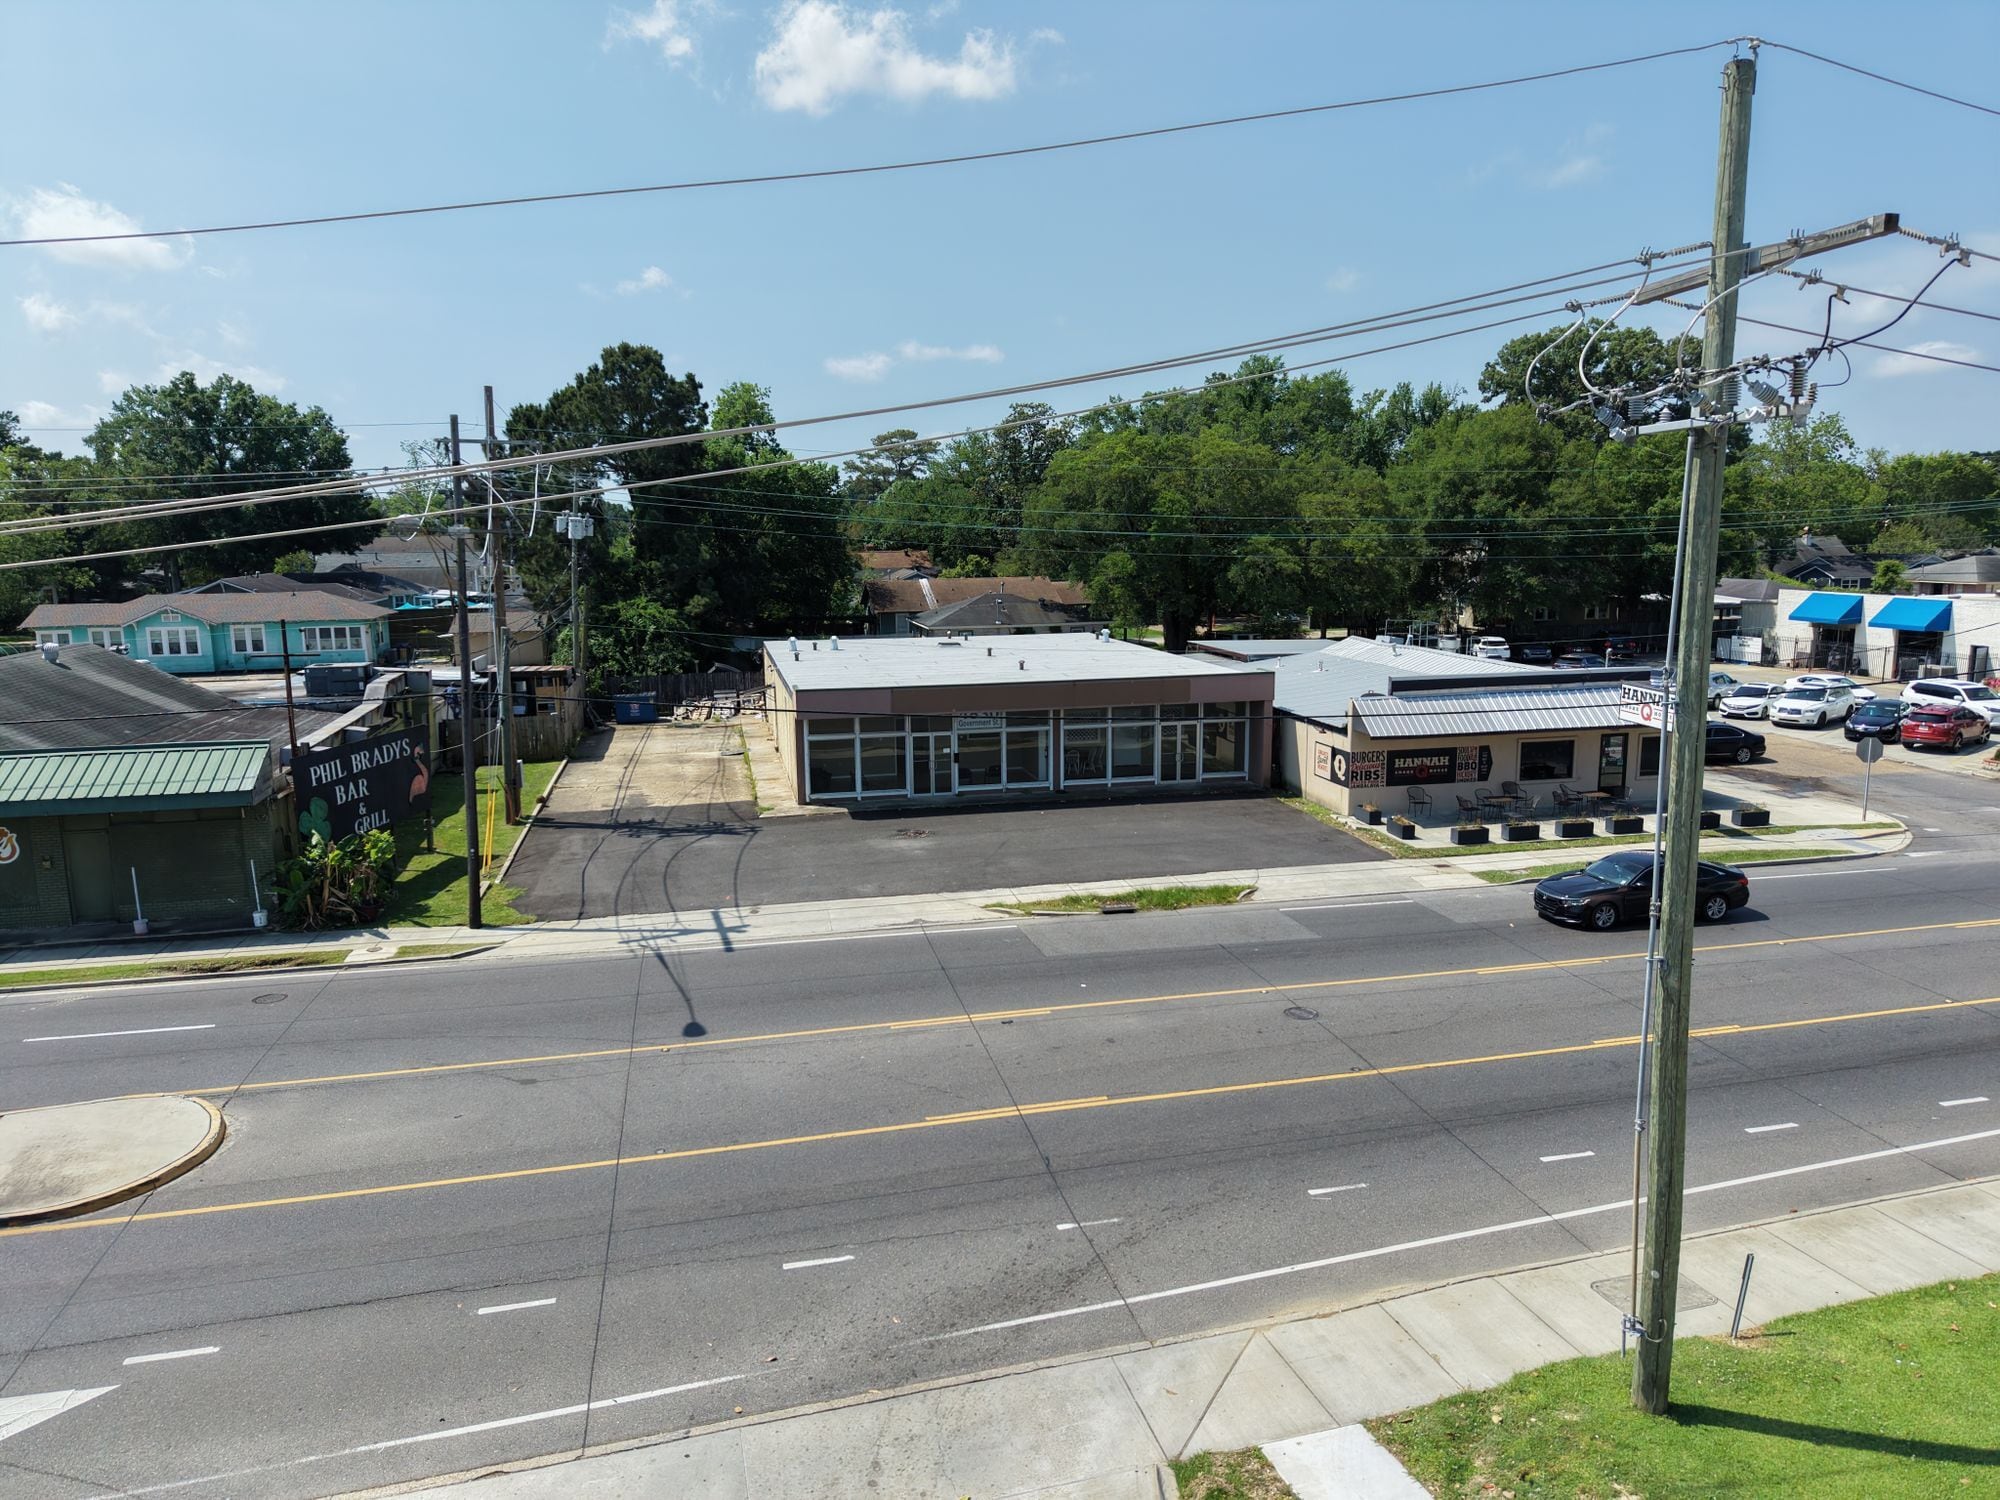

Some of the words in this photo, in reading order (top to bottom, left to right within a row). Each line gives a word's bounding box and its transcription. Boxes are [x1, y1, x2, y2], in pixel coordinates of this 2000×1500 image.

[1640, 703, 1652, 721] Q
[958, 719, 991, 727] Government
[309, 759, 347, 787] PHIL
[350, 738, 411, 774] BRADYS
[1351, 750, 1386, 763] BURGERS
[1394, 756, 1450, 768] HANNAH
[1334, 754, 1346, 781] Q
[1351, 770, 1380, 781] RIBS
[334, 778, 370, 805] BAR
[358, 802, 367, 815] &
[354, 809, 390, 835] GRILL
